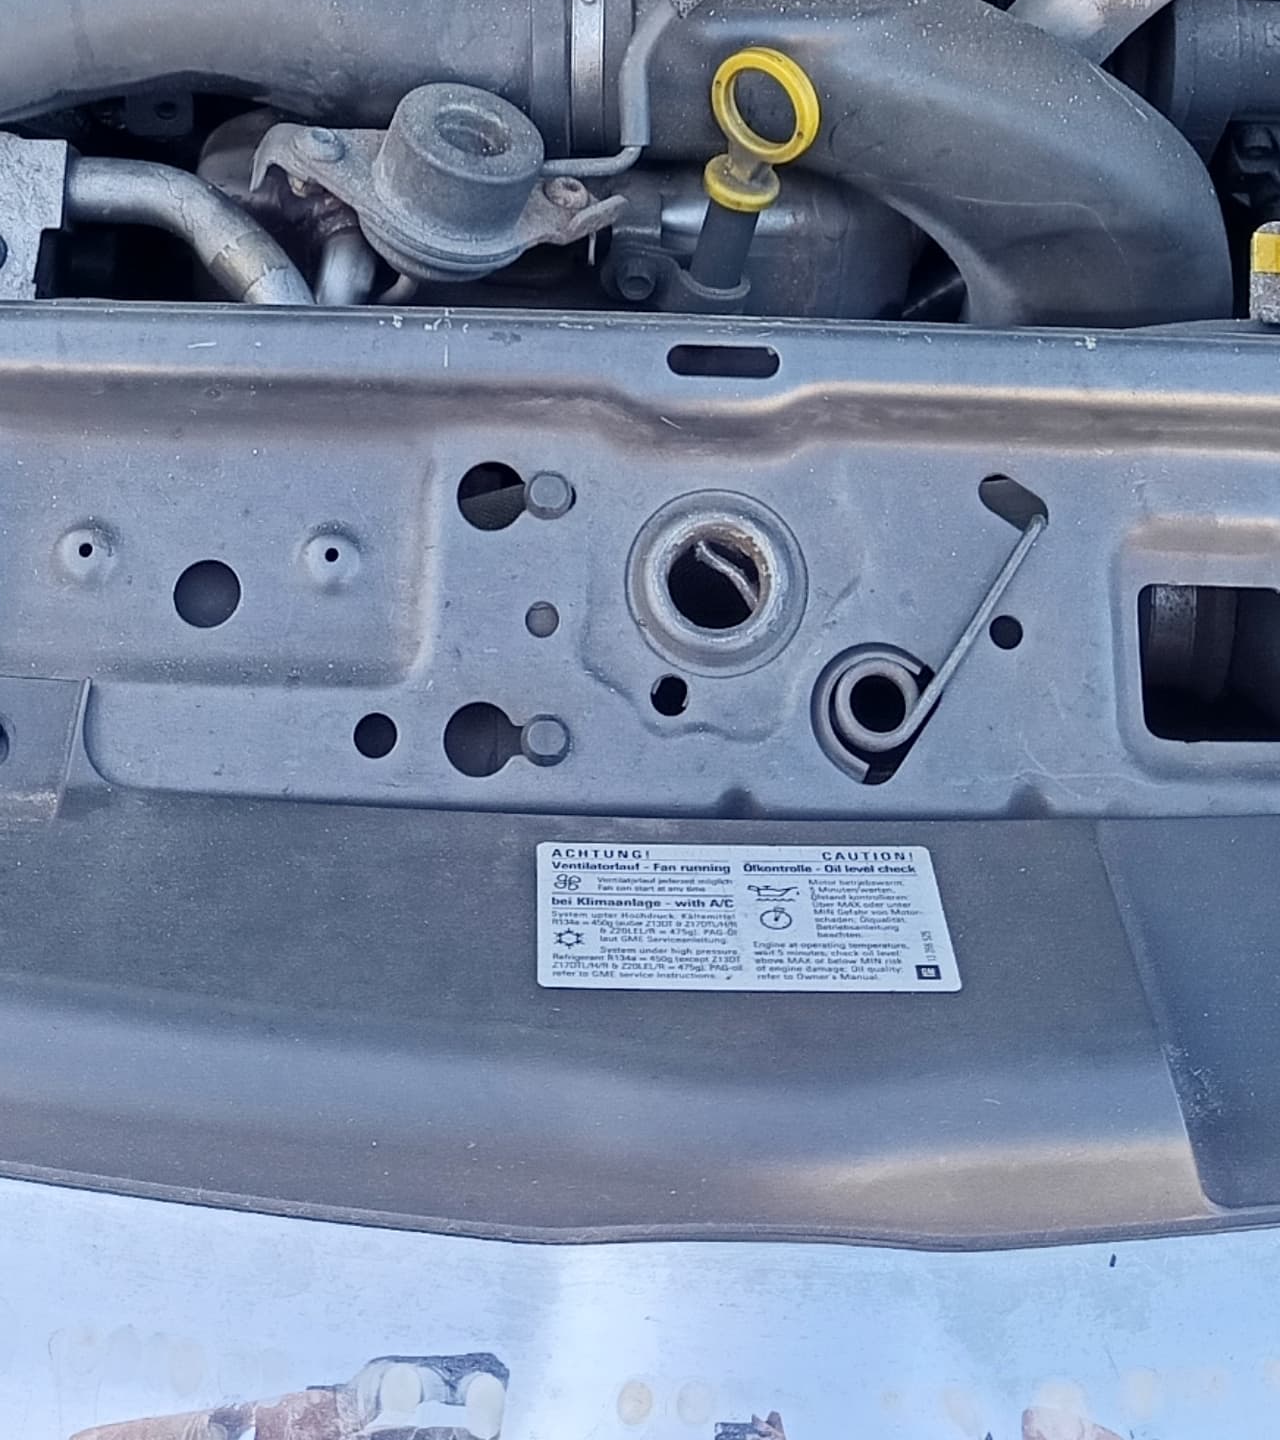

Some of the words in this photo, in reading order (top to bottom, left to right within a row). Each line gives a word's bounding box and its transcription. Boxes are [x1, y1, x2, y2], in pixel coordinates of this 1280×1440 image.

[552, 848, 649, 858] ACHTUNG!
[821, 851, 912, 861] CAUTION!
[552, 861, 639, 872] Ventilatorlauf
[652, 862, 676, 873] Fan
[680, 863, 730, 873] running
[743, 863, 811, 872] Ölkontrolle
[824, 864, 841, 873] Oil
[844, 864, 874, 872] level
[877, 864, 915, 872] check
[551, 896, 572, 905] bei
[576, 897, 660, 907] Klimaanlage
[674, 898, 705, 907] with
[709, 898, 733, 908] A/C
